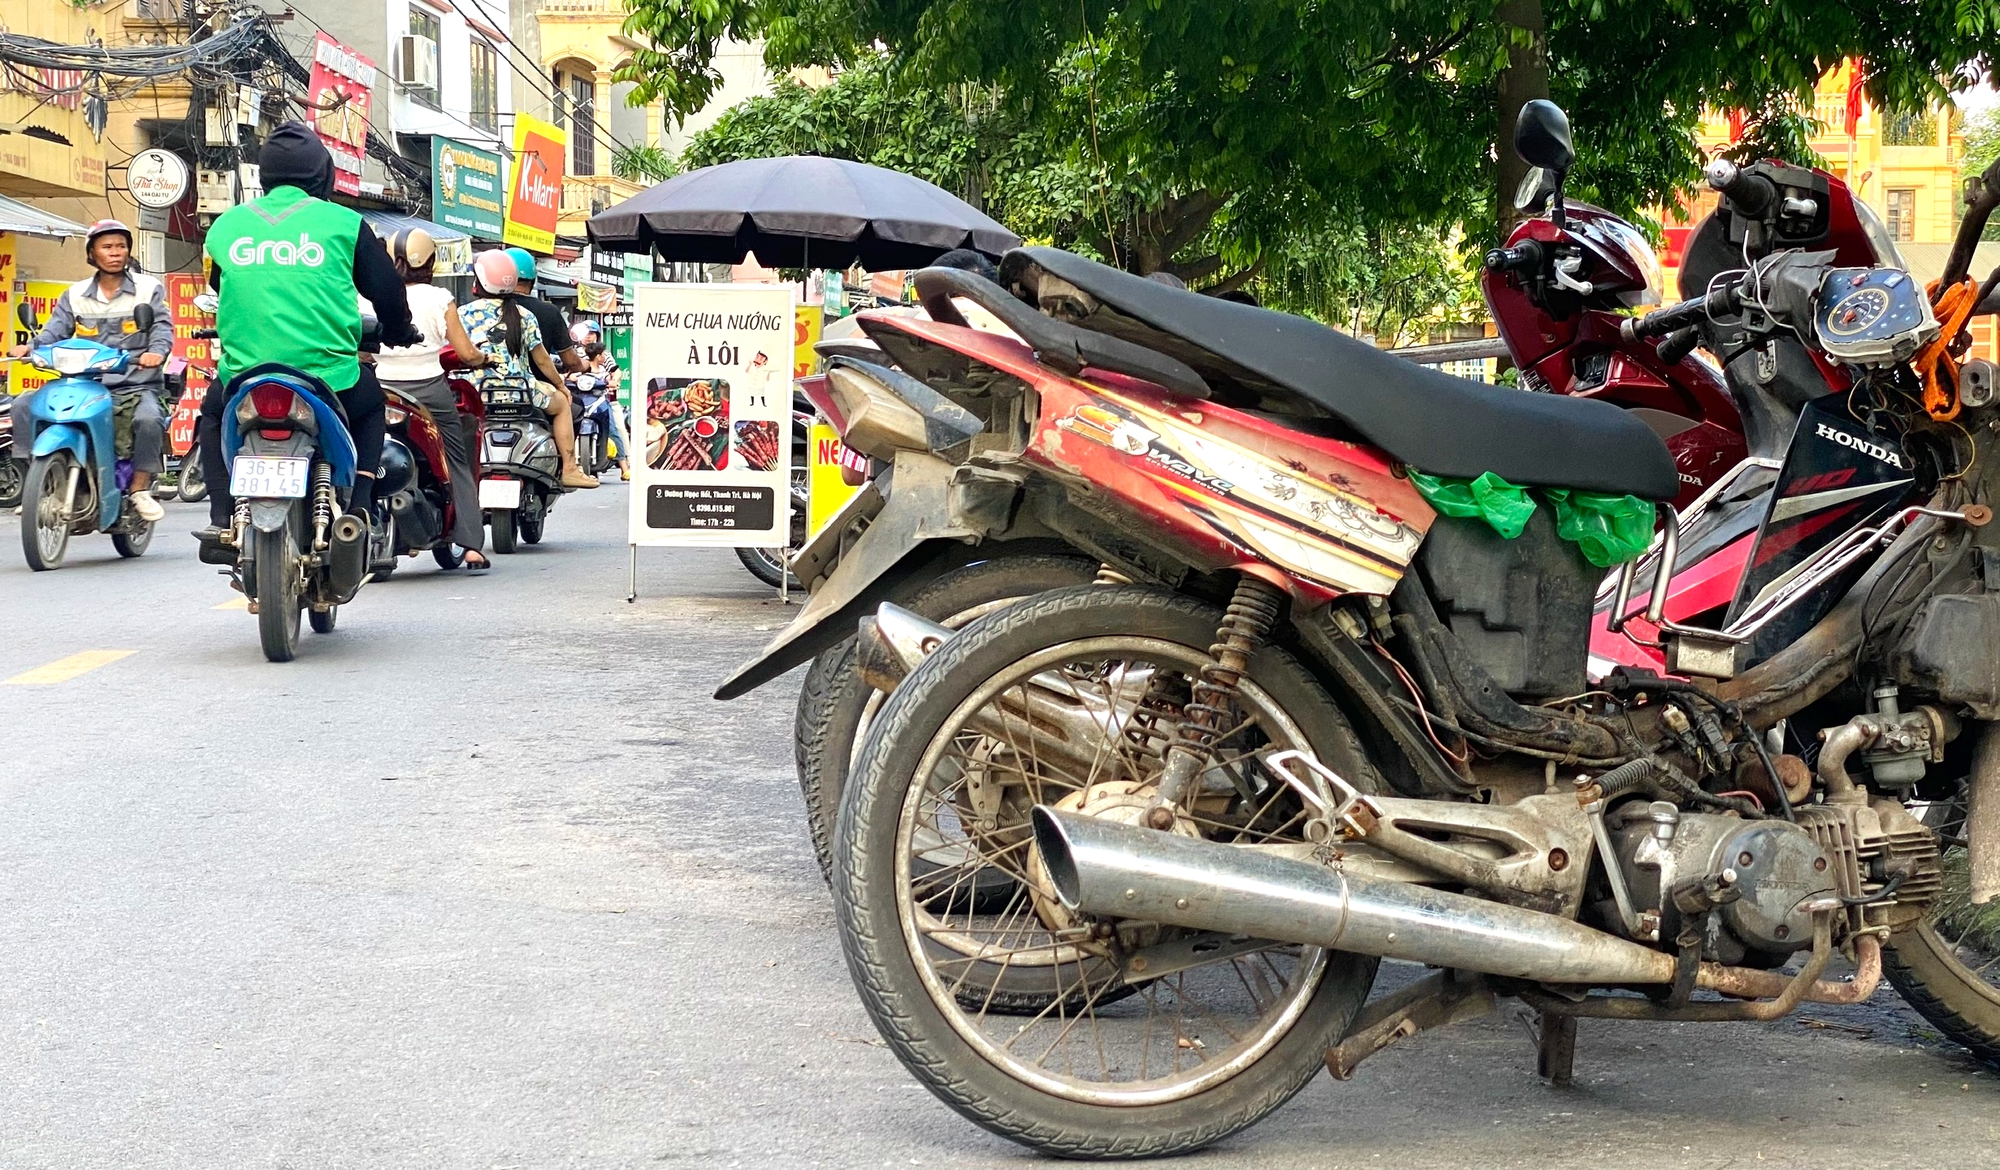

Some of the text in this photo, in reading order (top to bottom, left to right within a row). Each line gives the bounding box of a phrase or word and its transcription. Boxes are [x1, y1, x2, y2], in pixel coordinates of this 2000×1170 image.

[154, 177, 178, 192] Shop
[519, 152, 554, 210] K-Mart
[229, 232, 325, 267] Grab
[645, 312, 680, 328] NEM
[683, 312, 723, 330] CHUA
[727, 311, 782, 330] NƯỚNG
[186, 343, 206, 359] CŨ
[687, 339, 739, 365] À LÔI
[175, 424, 192, 442] LẤY
[1815, 422, 1903, 468] HONDA
[246, 460, 296, 476] 36-E1
